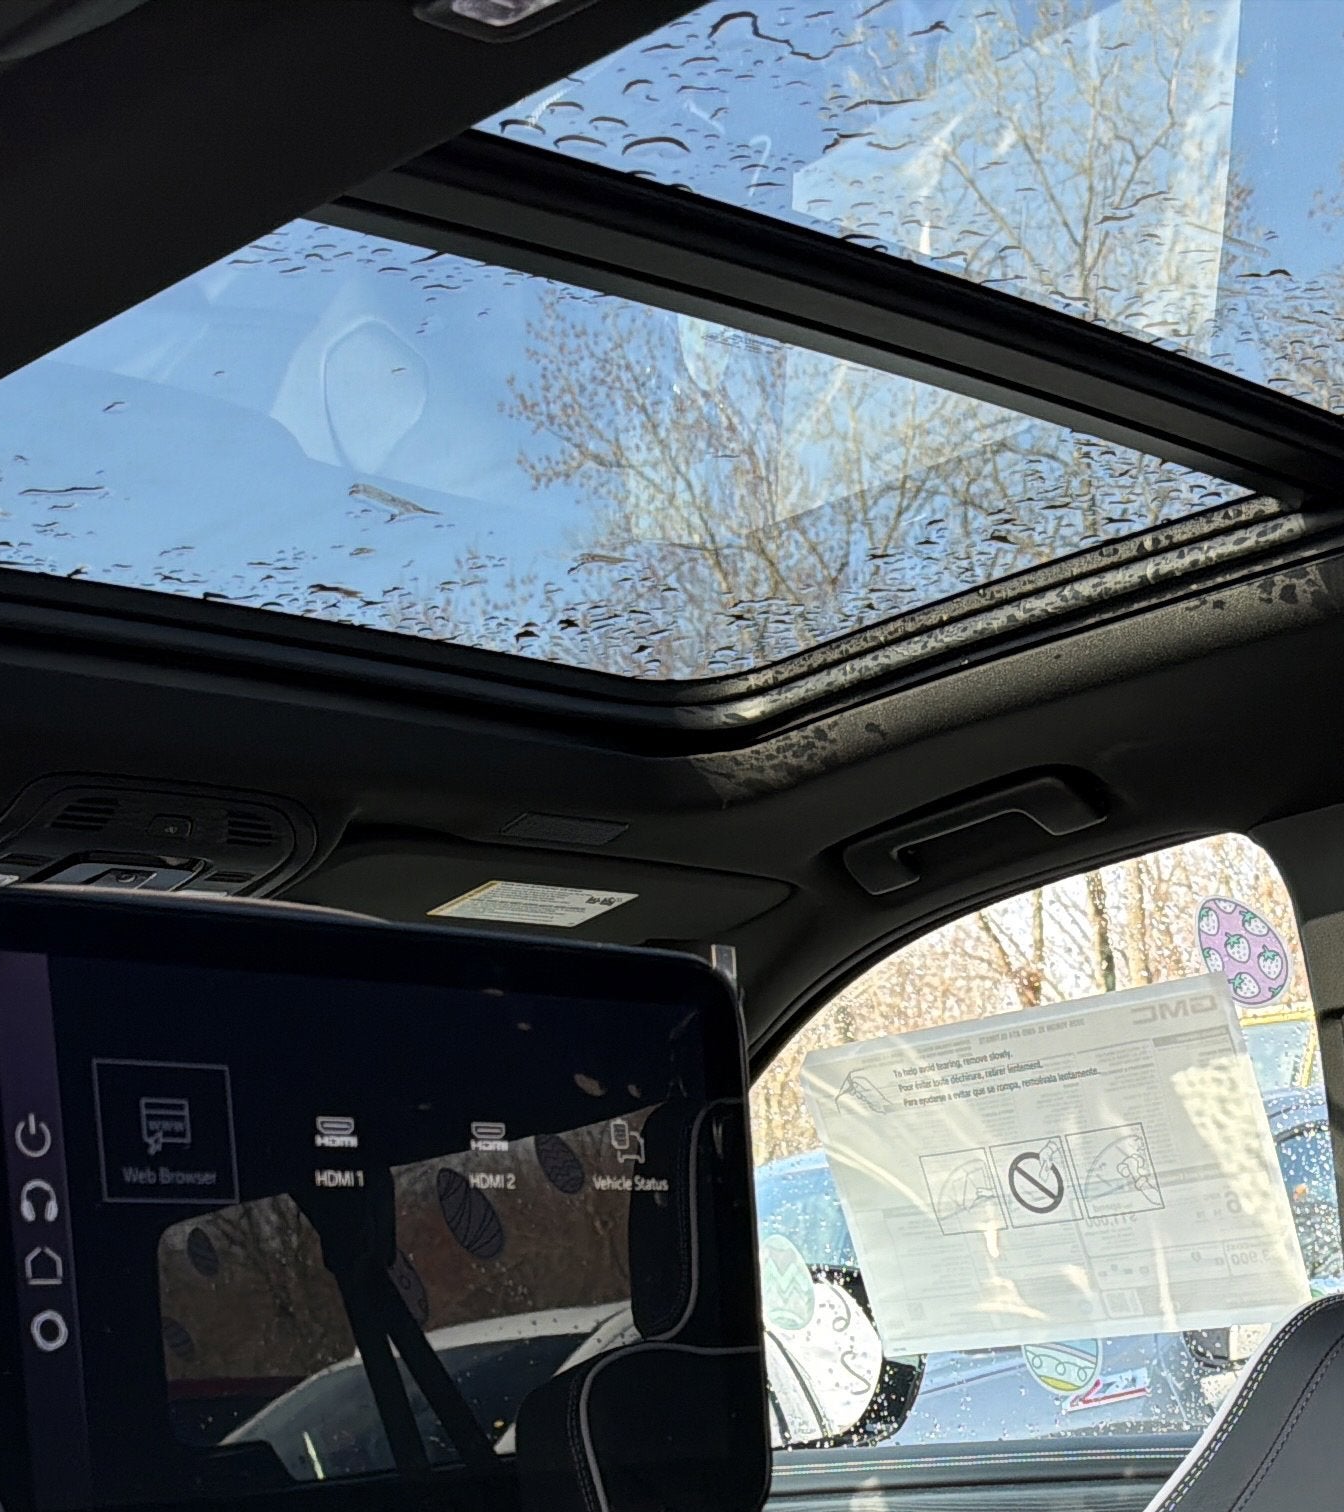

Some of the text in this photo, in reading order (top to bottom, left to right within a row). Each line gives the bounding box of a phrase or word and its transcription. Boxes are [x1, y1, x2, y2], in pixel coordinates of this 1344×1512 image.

[893, 1069, 902, 1078] To
[902, 1067, 918, 1077] help
[919, 1063, 935, 1073] avoid
[963, 1055, 988, 1065] remove
[972, 1087, 985, 1097] que
[987, 1085, 996, 1094] se
[122, 1167, 216, 1185] Web Browser
[315, 1169, 365, 1187] HDMI 1
[469, 1173, 516, 1190] HDMI 2
[592, 1174, 669, 1192] Vehicle Status
